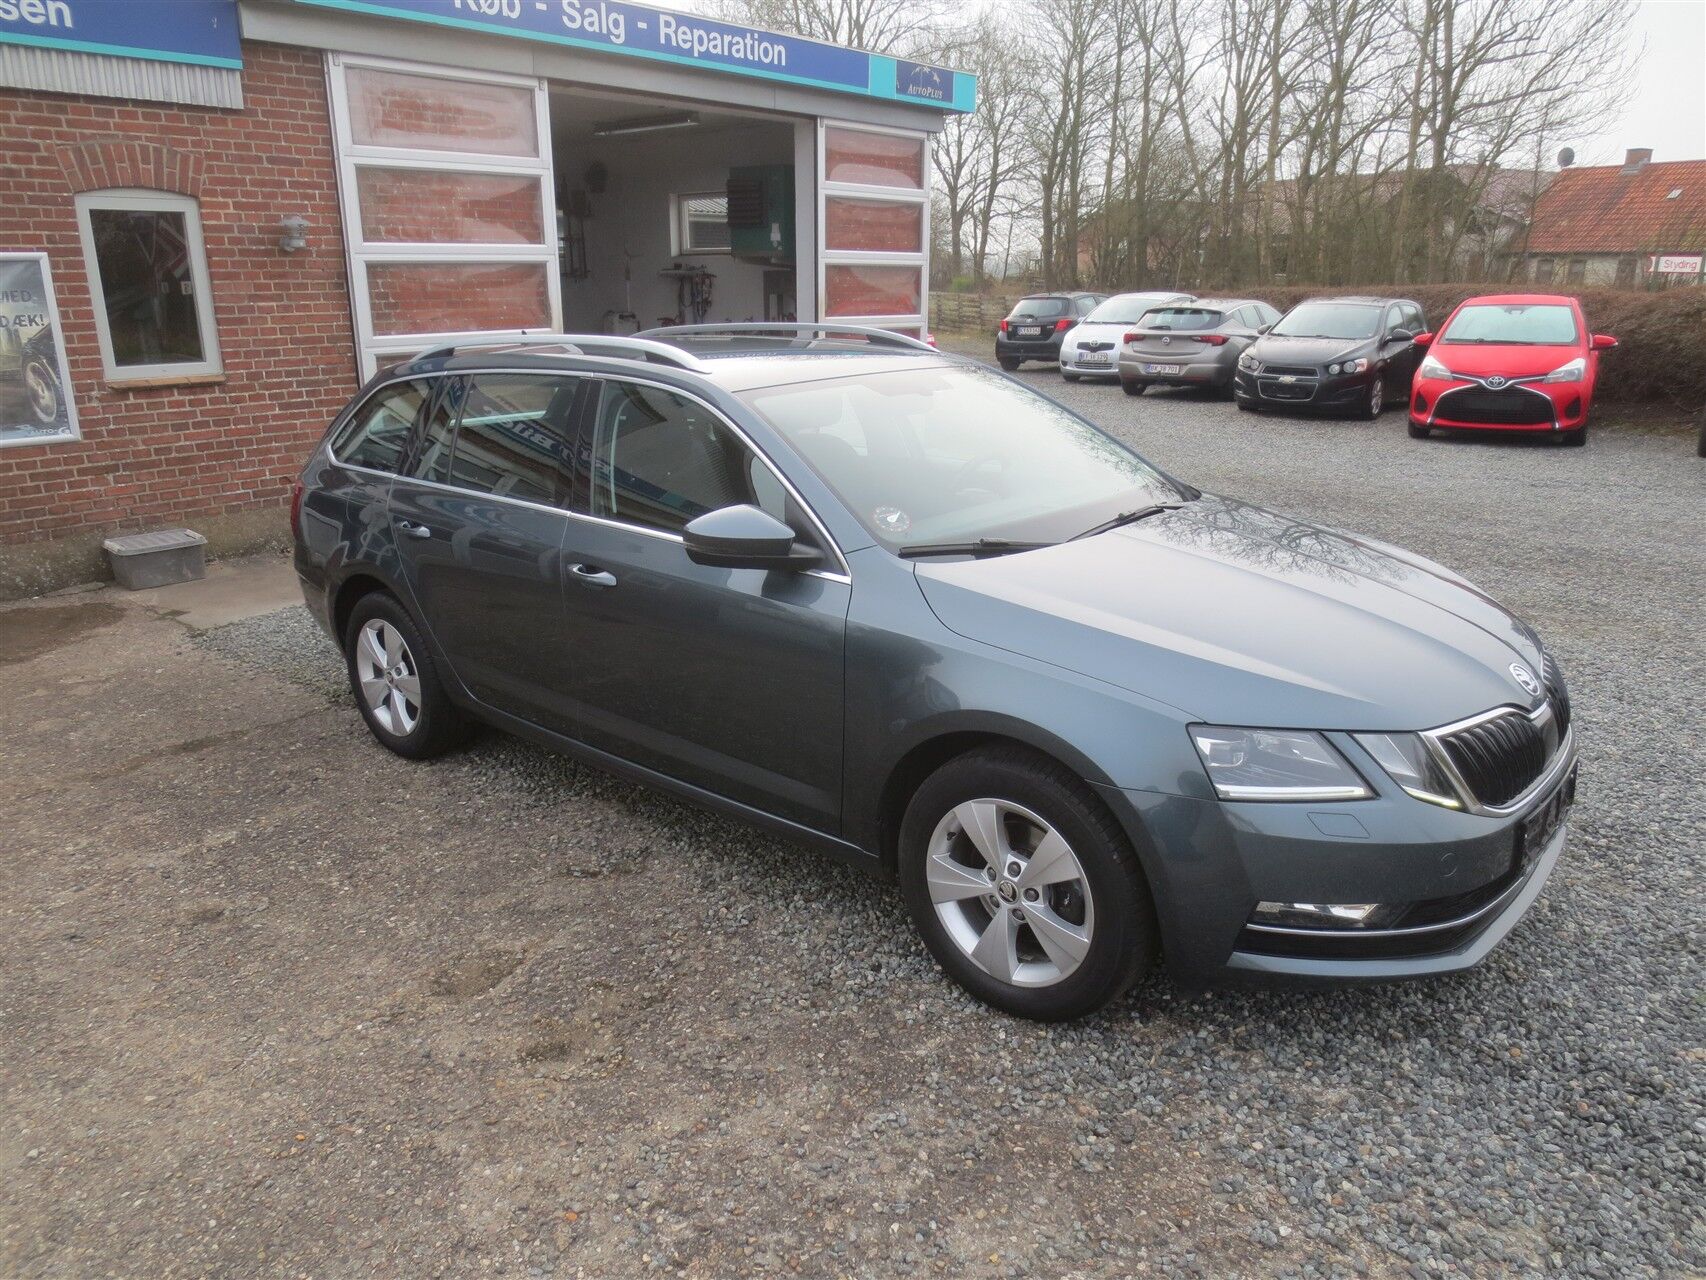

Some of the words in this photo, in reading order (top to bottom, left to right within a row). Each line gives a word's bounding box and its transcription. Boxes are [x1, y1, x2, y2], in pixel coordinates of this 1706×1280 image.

[0, 0, 73, 28] sen
[561, 0, 626, 44] Salg
[659, 14, 787, 66] Reparation
